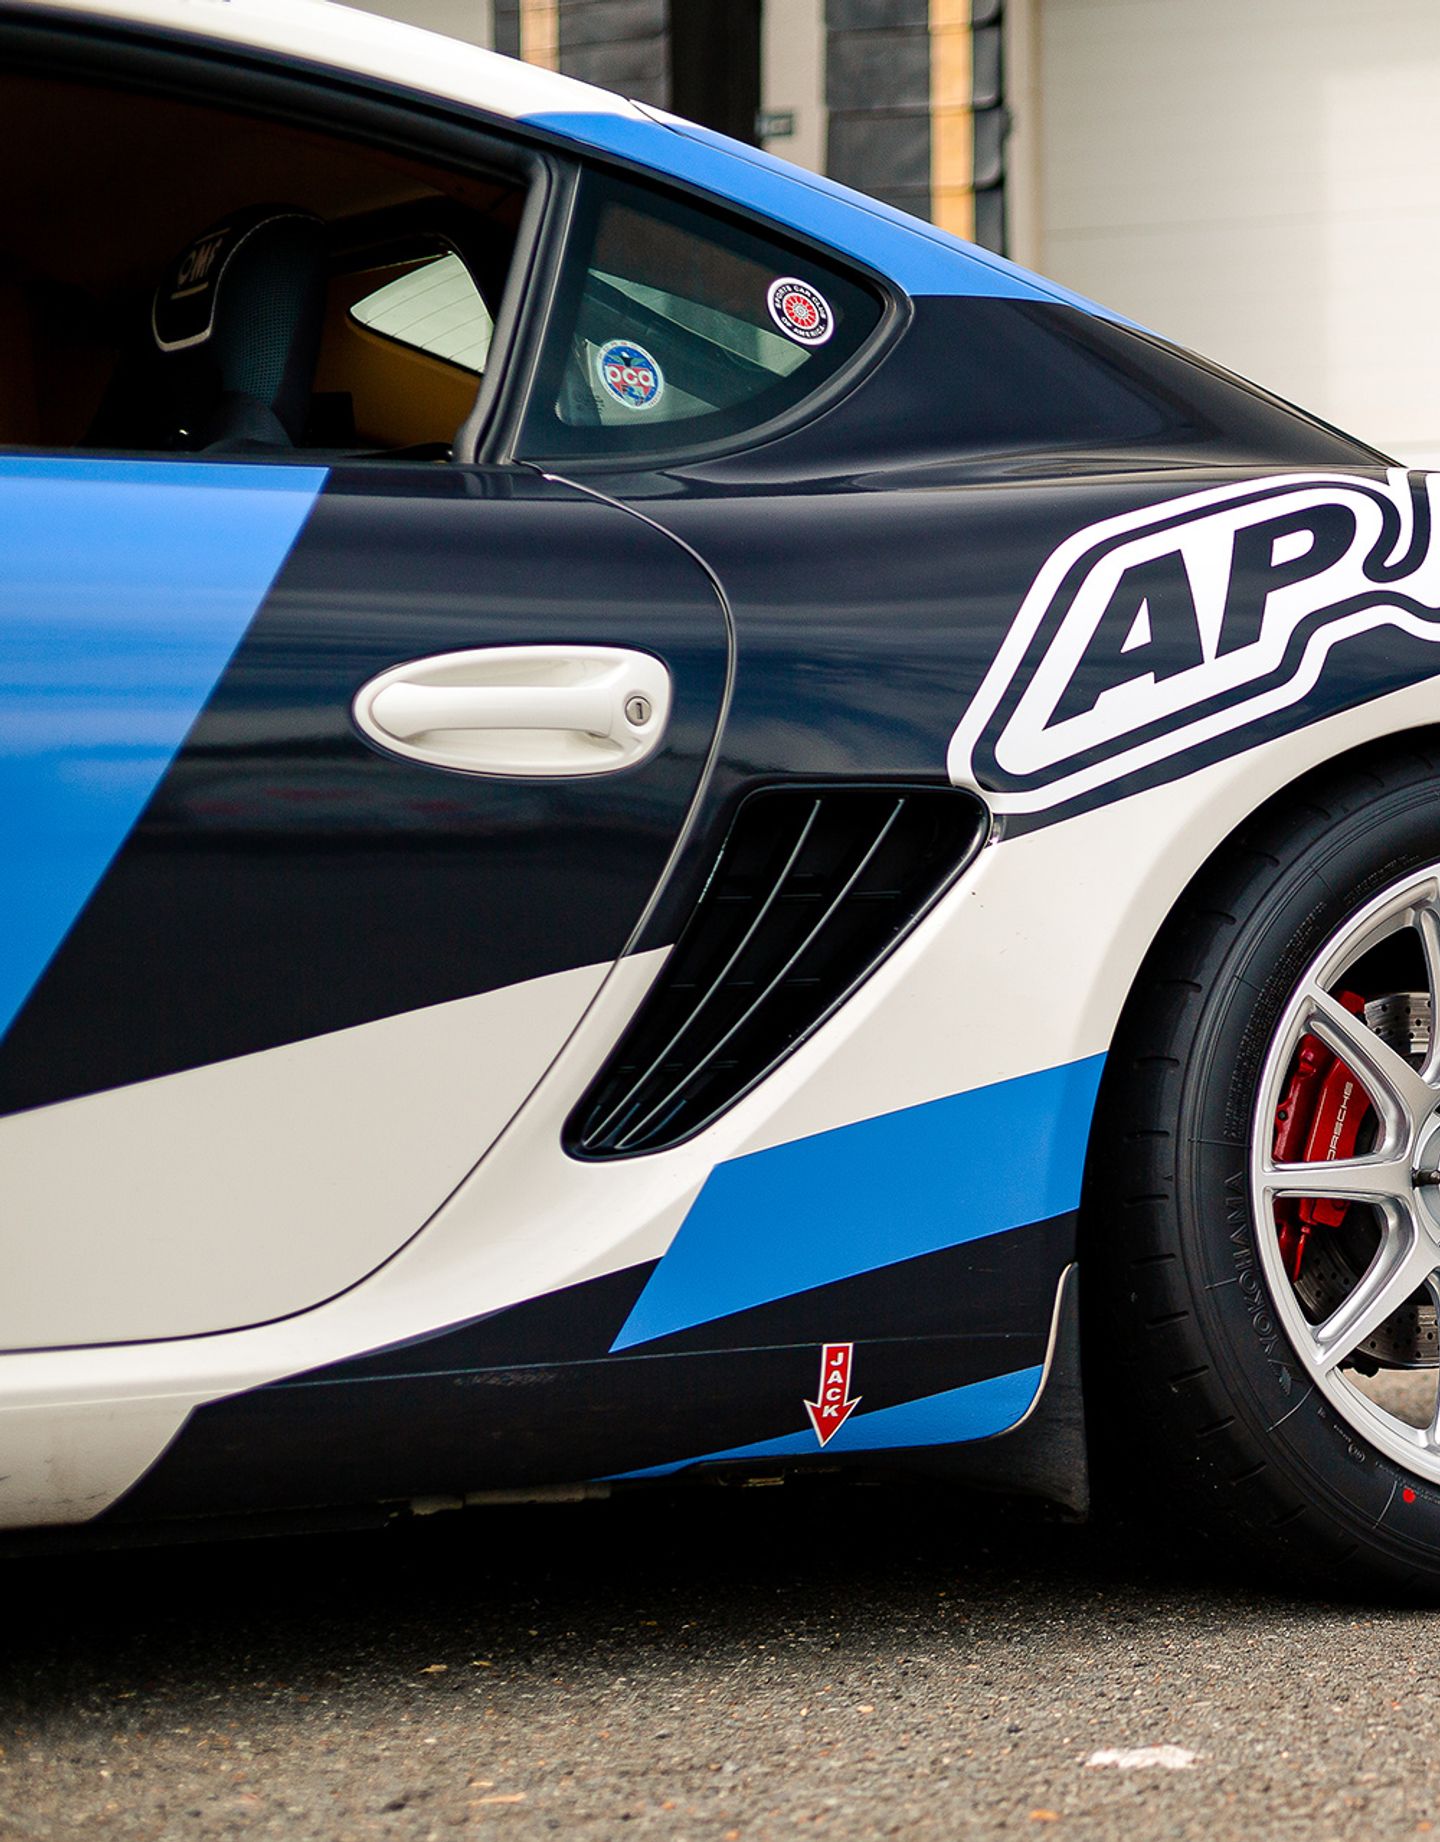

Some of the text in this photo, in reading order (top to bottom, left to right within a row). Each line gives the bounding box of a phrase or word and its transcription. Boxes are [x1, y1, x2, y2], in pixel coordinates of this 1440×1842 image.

[774, 285, 826, 319] SPORTS CAR CLUB
[781, 316, 826, 338] OF AMERICA
[604, 364, 656, 388] pca
[1326, 1080, 1354, 1161] ORSCHE
[1223, 1171, 1280, 1357] YOKOHAMA
[822, 1351, 845, 1419] JACK
